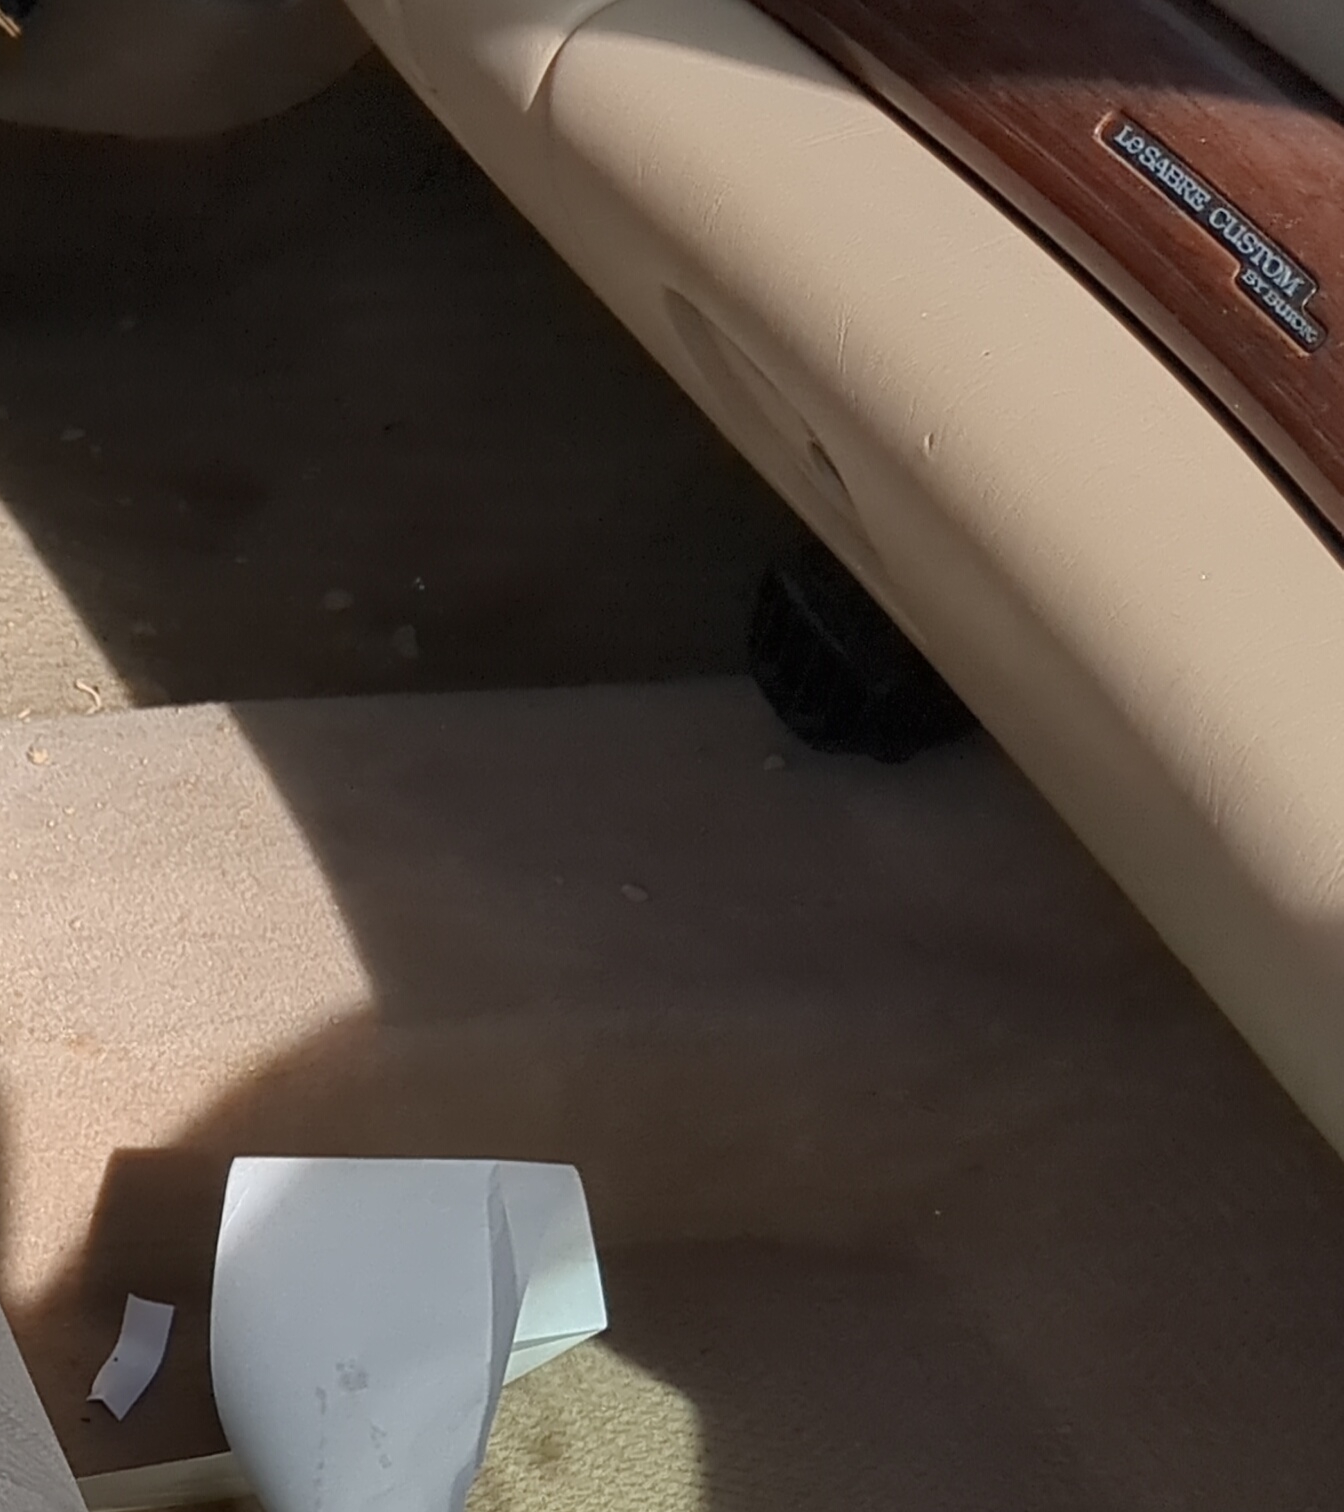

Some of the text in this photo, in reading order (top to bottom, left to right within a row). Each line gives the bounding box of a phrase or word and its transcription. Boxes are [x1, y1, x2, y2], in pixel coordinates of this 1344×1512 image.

[1209, 207, 1304, 297] CUSTOM
[1242, 269, 1318, 343] BY BUICK
